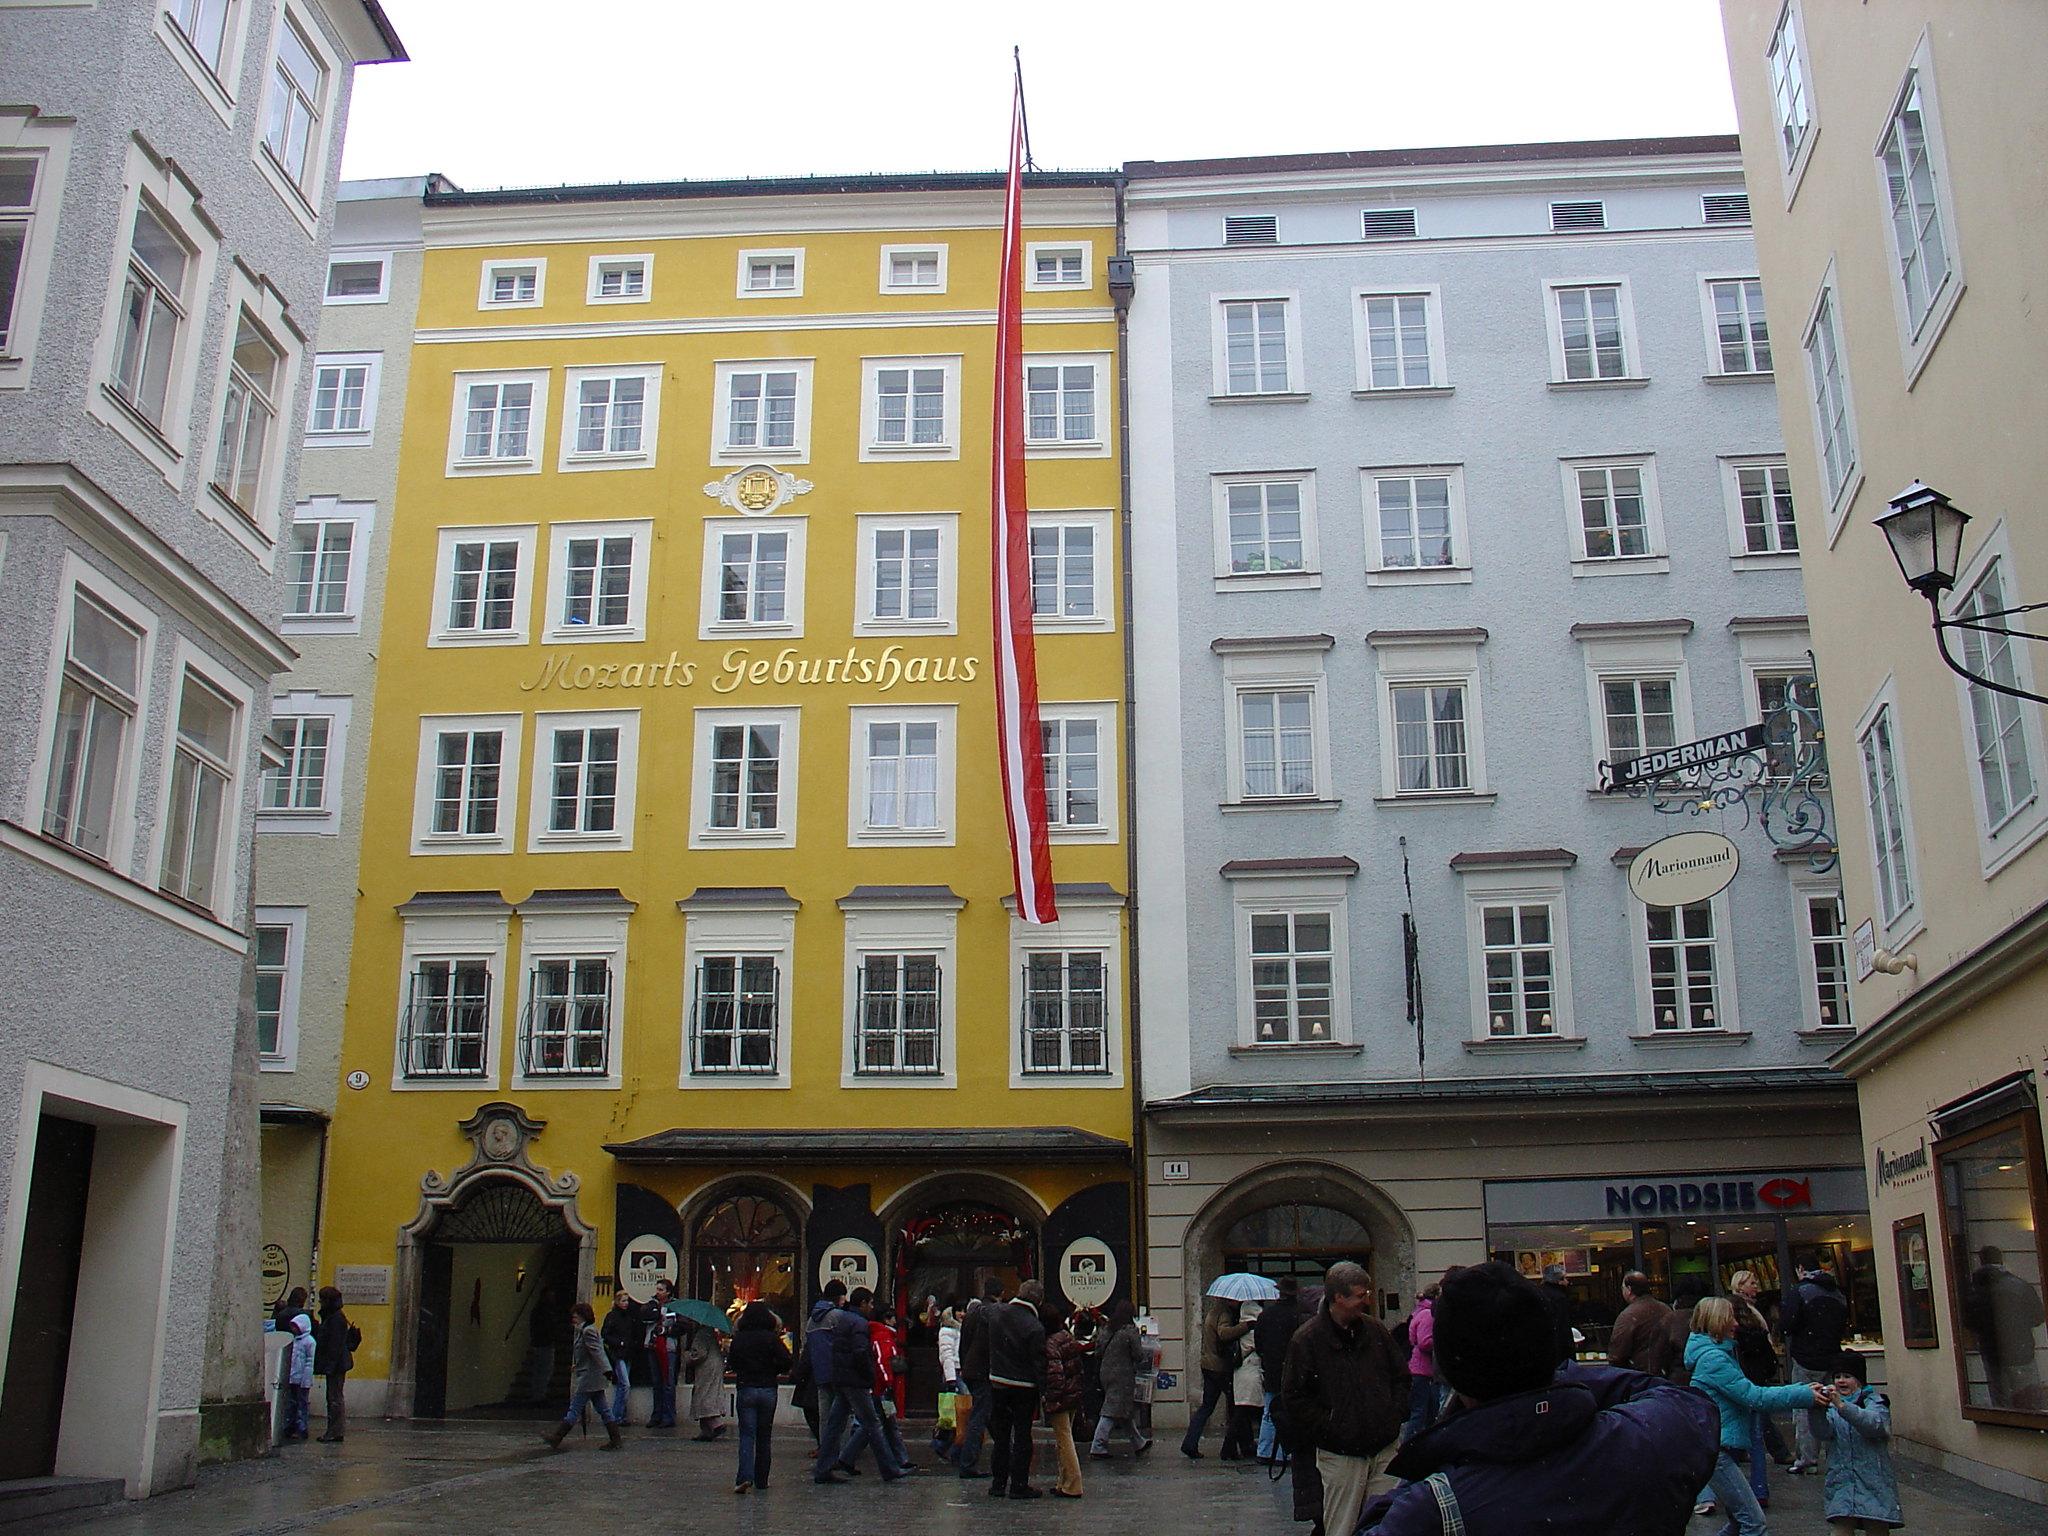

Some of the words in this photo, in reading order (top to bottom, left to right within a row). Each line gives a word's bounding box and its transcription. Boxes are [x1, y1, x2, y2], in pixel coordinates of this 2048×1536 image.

[520, 650, 698, 692] Mozarts
[711, 645, 979, 693] Geburtshaus
[1625, 731, 1748, 779] JEDERMAN
[1638, 847, 1730, 885] Marionnaud
[355, 1073, 362, 1083] 9
[1876, 1135, 1928, 1197] Marionnaud
[1605, 1181, 1756, 1215] NORDSEE
